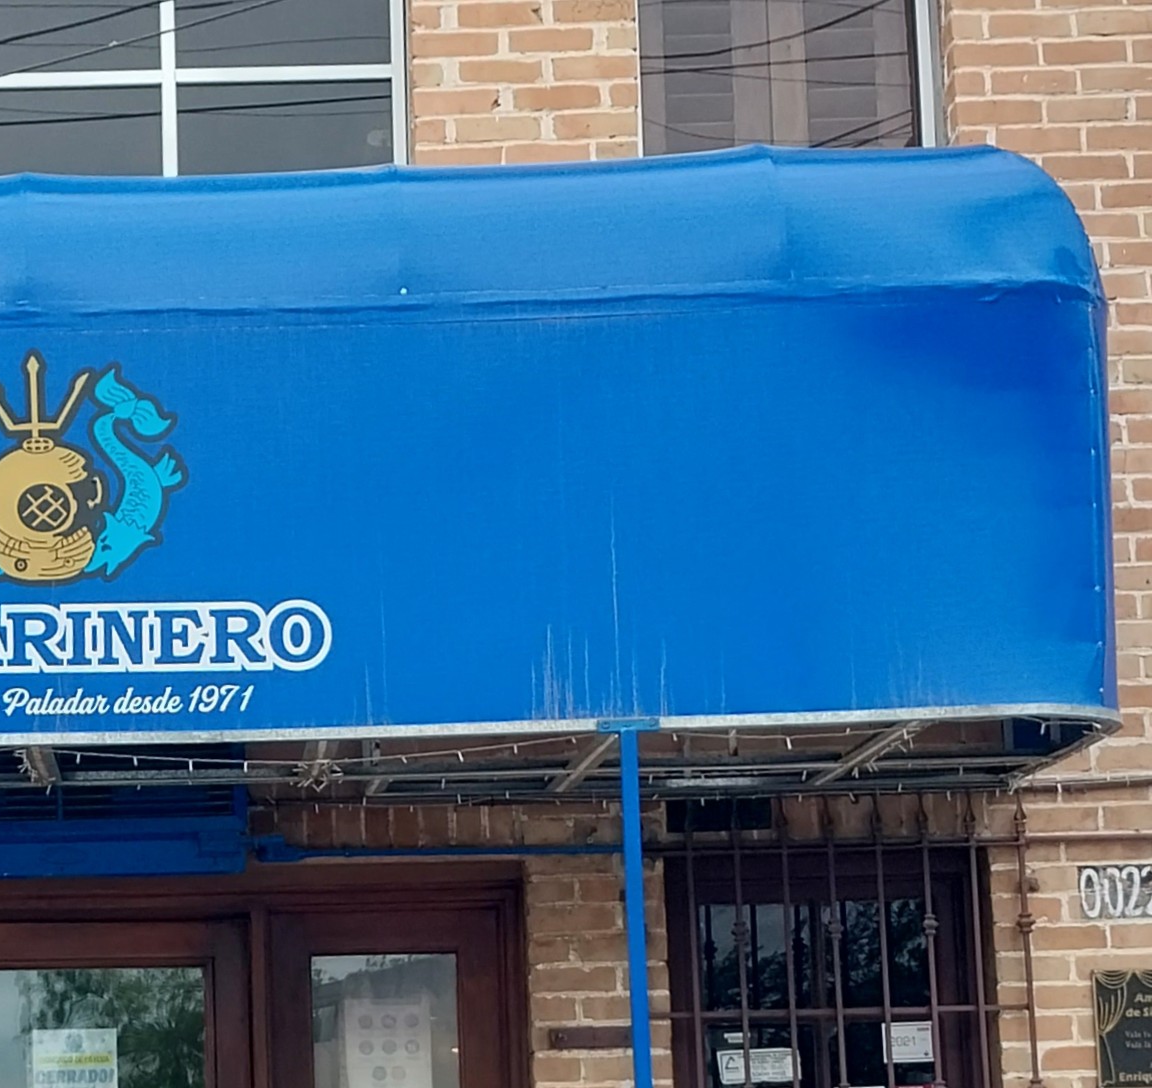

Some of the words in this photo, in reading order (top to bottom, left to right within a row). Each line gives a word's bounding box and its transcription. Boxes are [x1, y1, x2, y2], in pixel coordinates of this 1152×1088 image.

[2, 687, 111, 716] Paladar
[112, 685, 182, 714] desde
[188, 684, 254, 711] 1971
